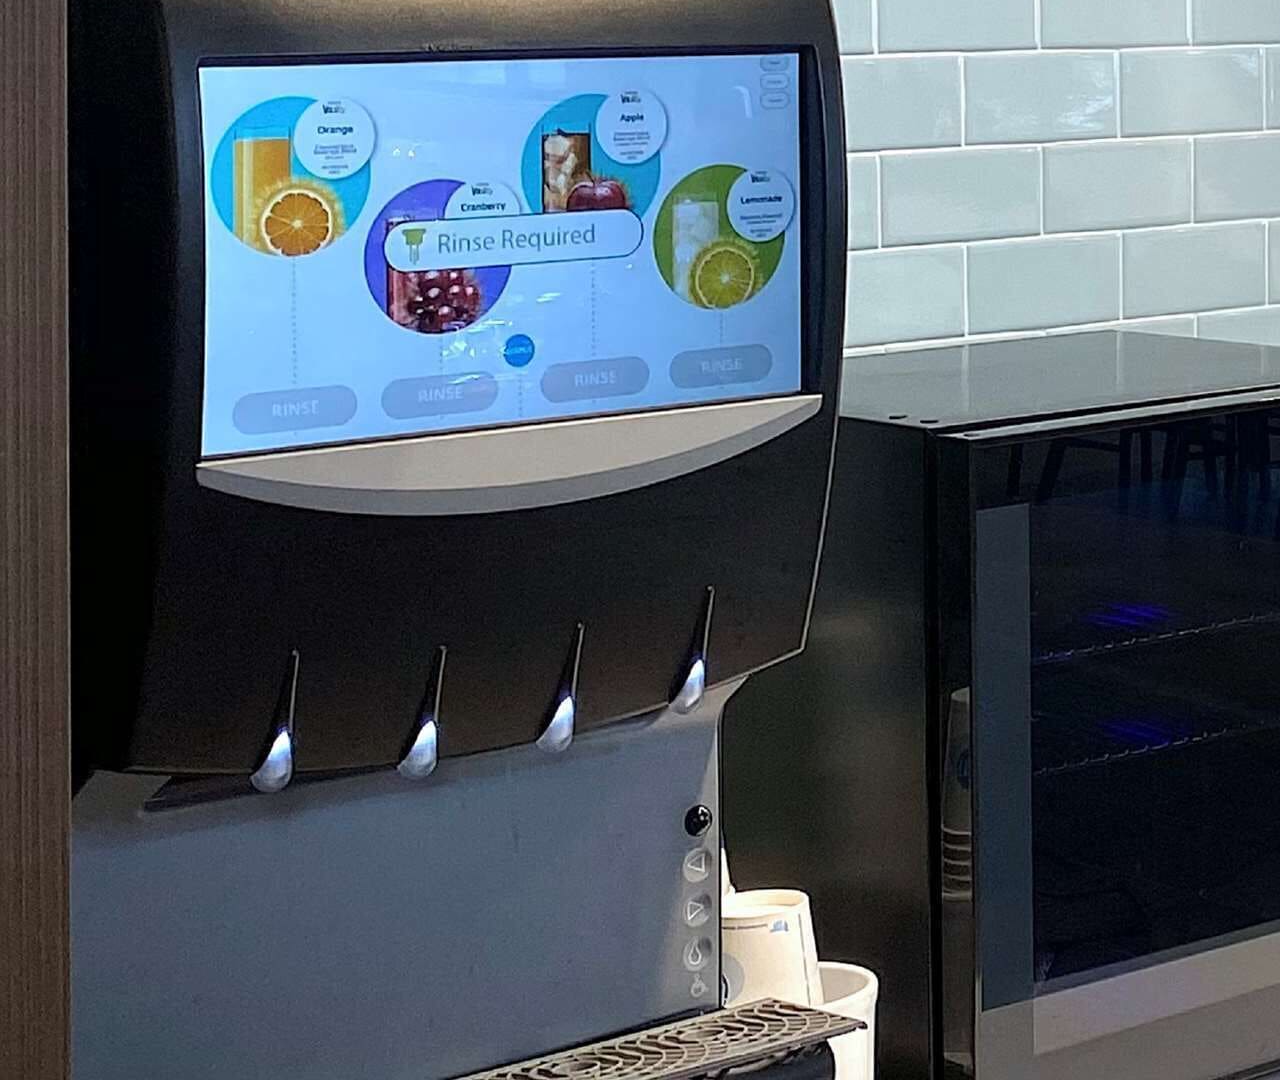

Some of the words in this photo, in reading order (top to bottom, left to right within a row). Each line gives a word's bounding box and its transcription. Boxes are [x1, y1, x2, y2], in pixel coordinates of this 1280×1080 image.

[317, 126, 354, 136] Orange
[459, 202, 507, 213] Cranberry
[437, 233, 496, 255] Rinse
[501, 223, 596, 252] Required
[701, 357, 743, 374] RINSE
[573, 370, 617, 388] RINSE
[417, 387, 464, 403] RINSE
[271, 398, 320, 417] RINSE
